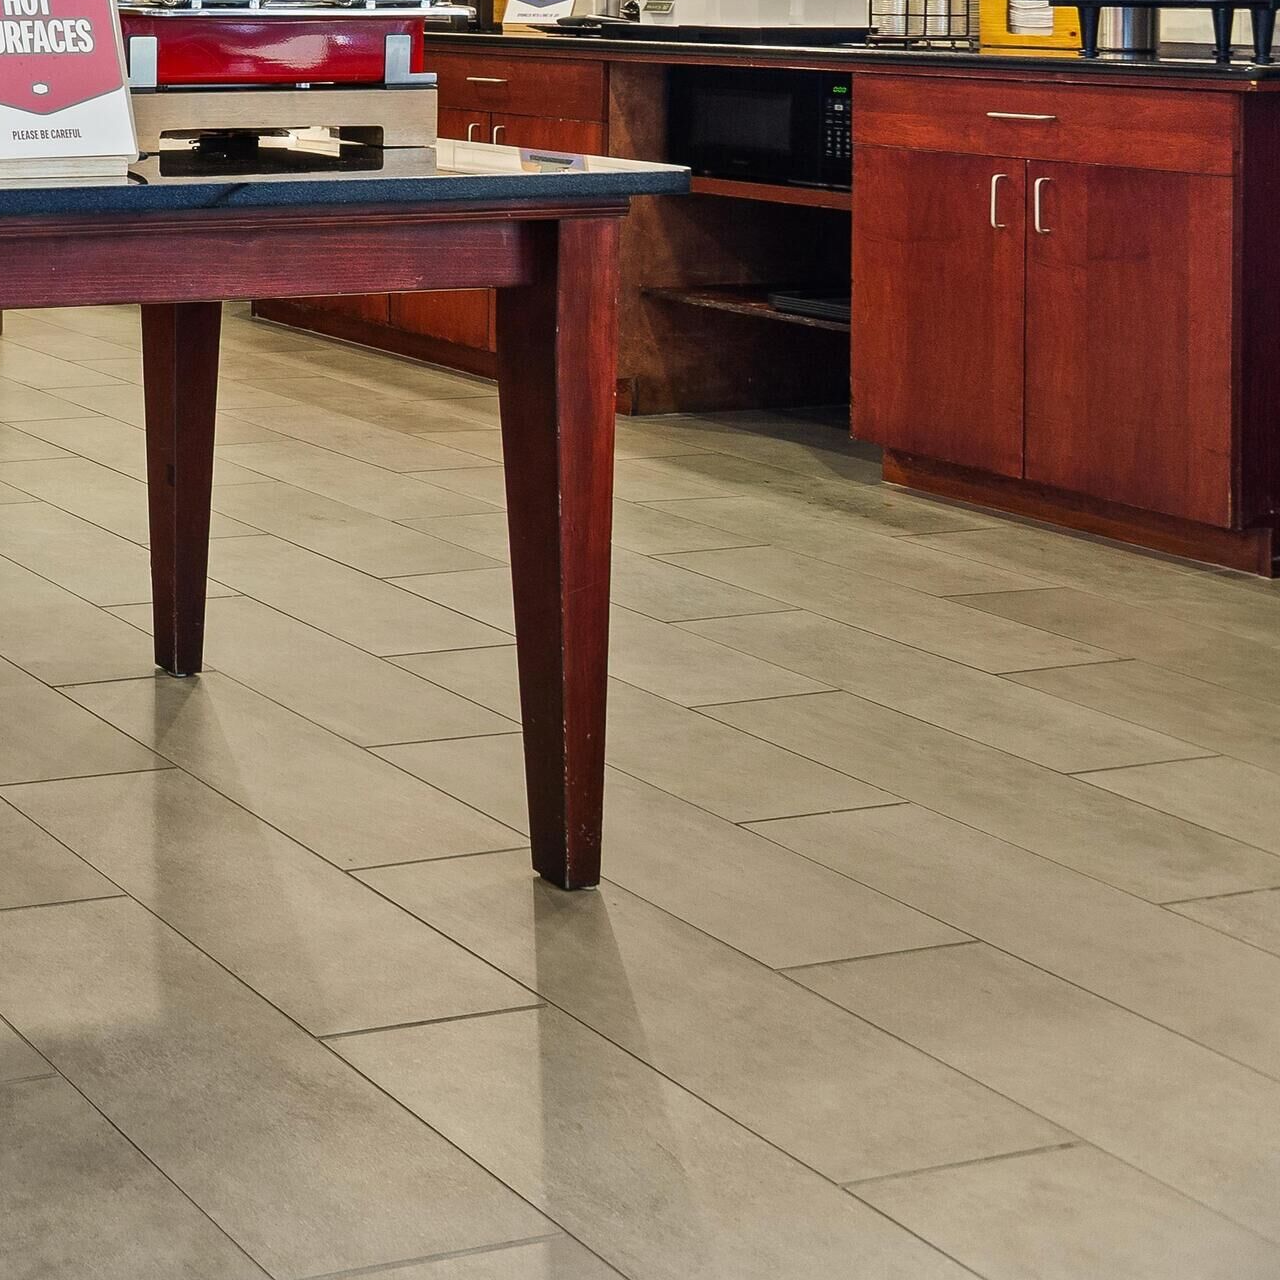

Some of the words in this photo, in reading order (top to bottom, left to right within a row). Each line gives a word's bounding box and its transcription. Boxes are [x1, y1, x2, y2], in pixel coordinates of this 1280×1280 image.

[12, 129, 39, 141] PLEASE
[40, 129, 50, 139] BE
[51, 128, 82, 139] CAREFUL
